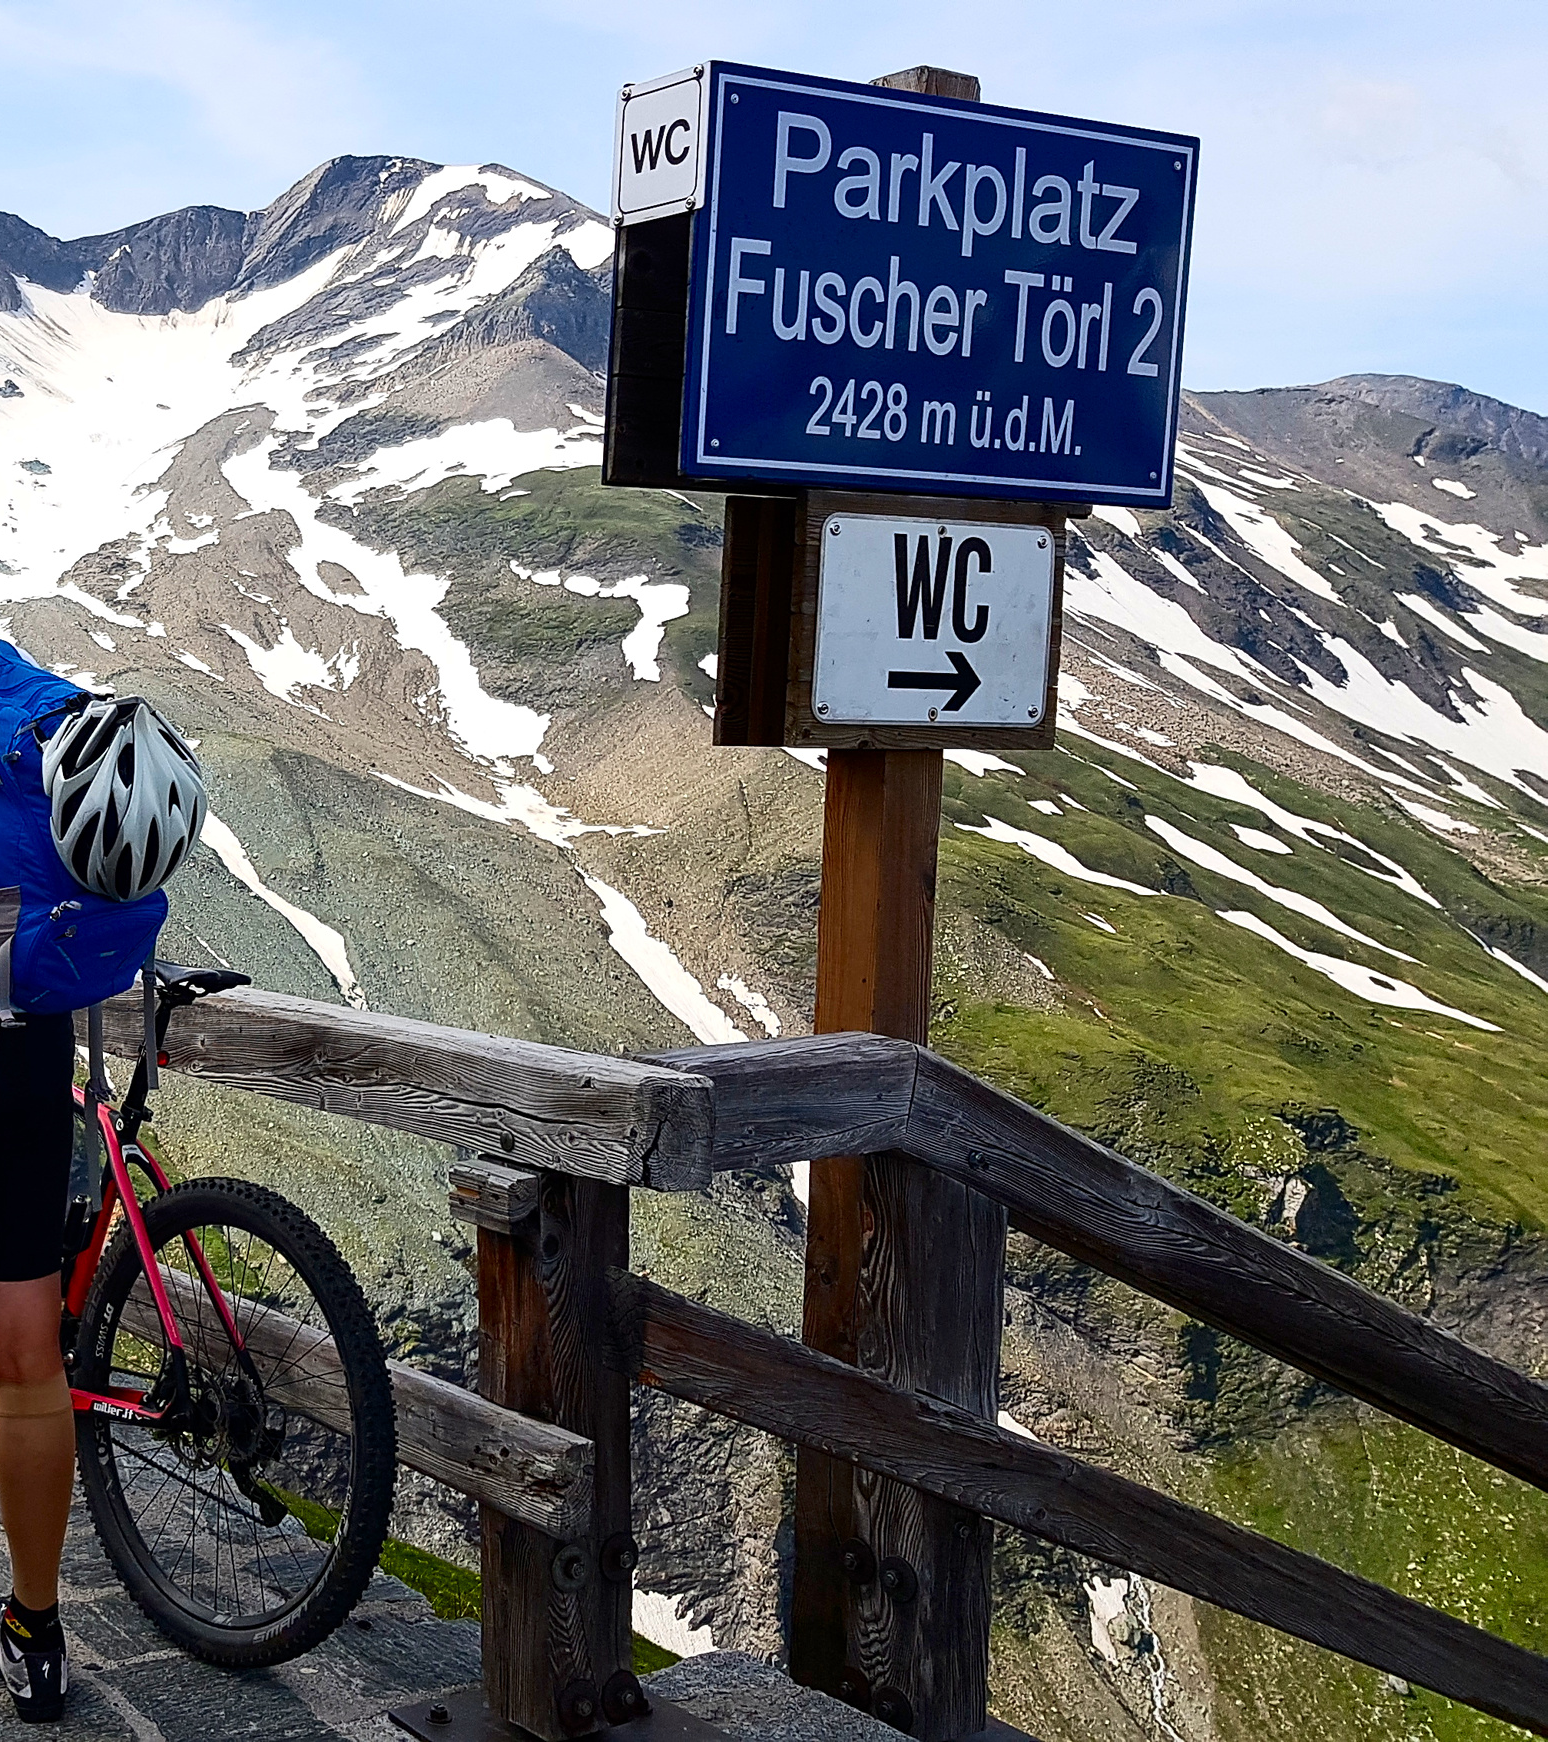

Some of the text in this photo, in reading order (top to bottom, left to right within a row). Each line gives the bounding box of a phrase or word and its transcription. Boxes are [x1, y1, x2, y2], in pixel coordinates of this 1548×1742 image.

[630, 118, 691, 175] WC
[772, 110, 1140, 257] Parkplatz
[725, 236, 1164, 378] Fuscher Törl 2
[805, 375, 1082, 456] 2428 m ü.d.M.
[893, 532, 993, 643] WC
[95, 1323, 109, 1359] SWISS
